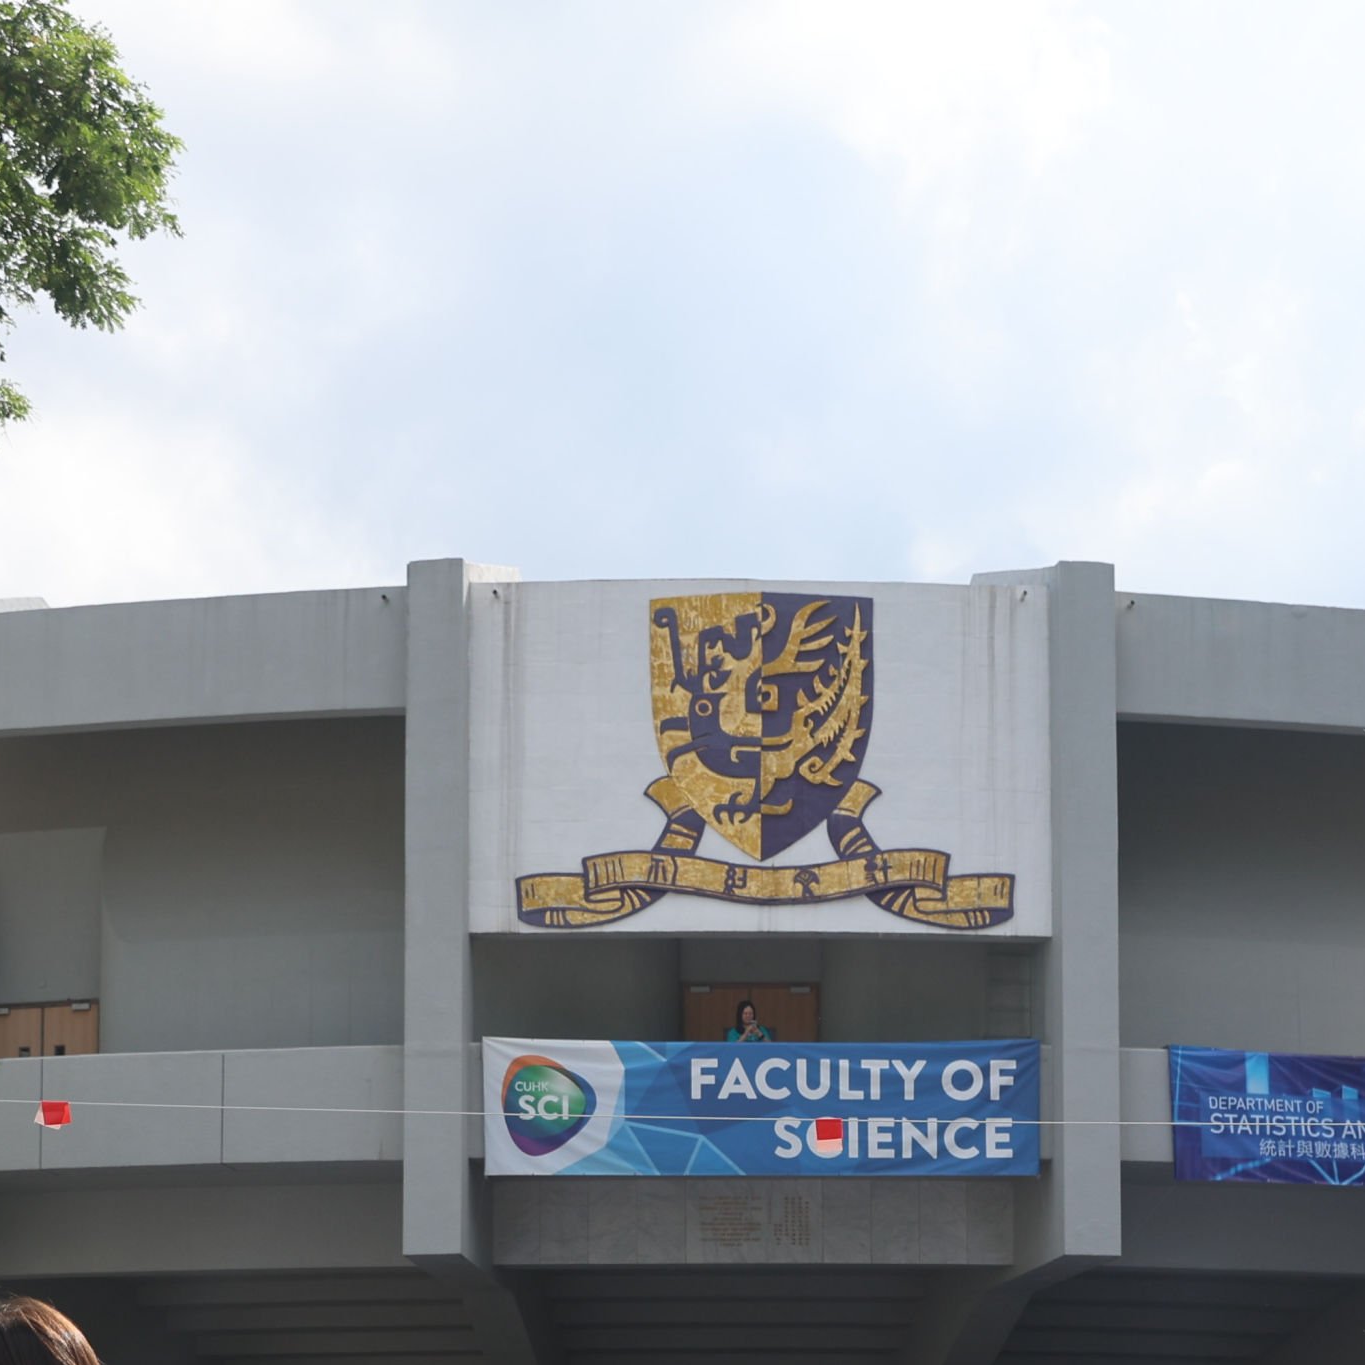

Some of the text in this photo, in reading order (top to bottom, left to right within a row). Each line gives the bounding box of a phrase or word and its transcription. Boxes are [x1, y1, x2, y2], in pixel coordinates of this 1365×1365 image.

[514, 1080, 549, 1093] CUHK
[690, 1057, 1018, 1100] FACULTY OF
[517, 1094, 571, 1121] SCI
[1208, 1096, 1324, 1114] DEPARTMENT OF
[774, 1116, 1015, 1159] SCIENCE
[1210, 1113, 1335, 1138] STATISTICS
